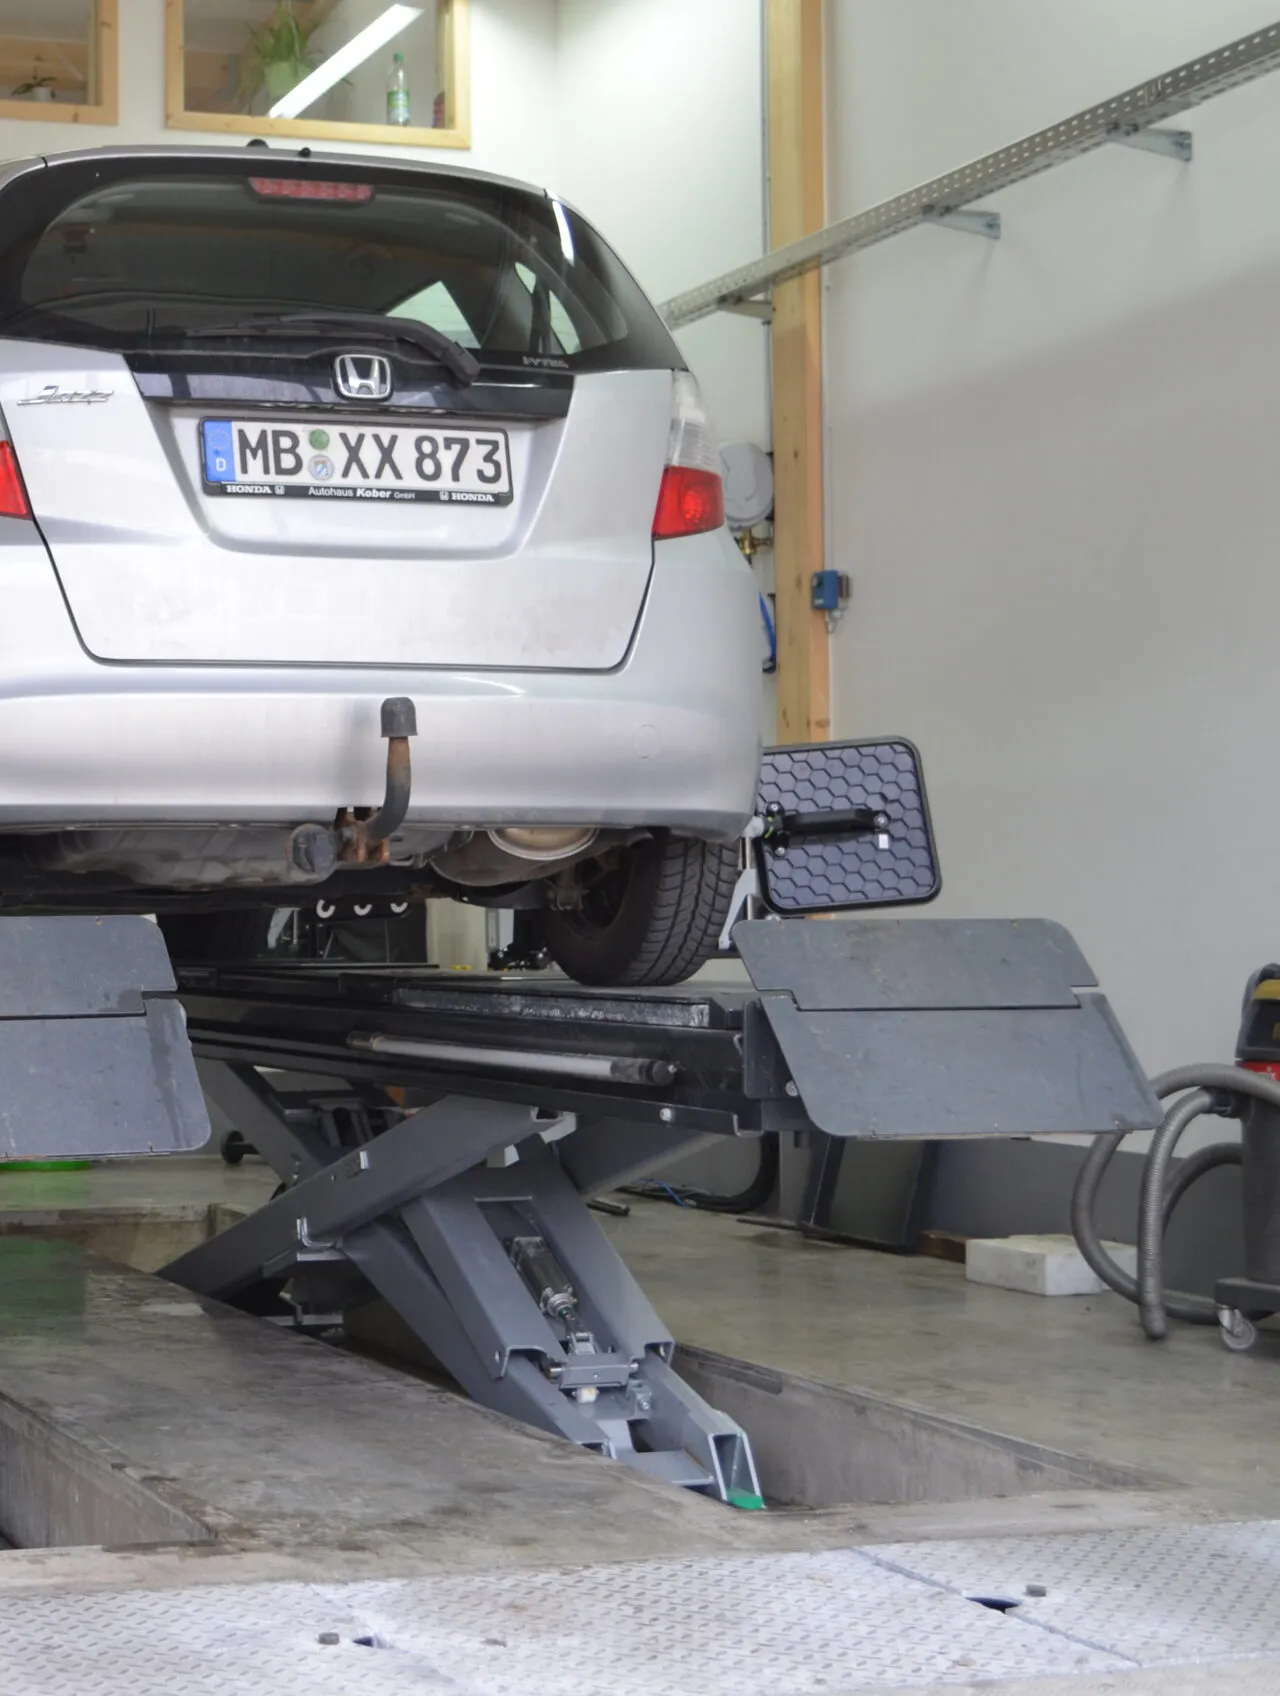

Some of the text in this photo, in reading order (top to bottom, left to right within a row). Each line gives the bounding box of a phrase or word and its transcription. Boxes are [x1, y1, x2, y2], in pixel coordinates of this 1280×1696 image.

[237, 428, 502, 484] MB XX 873
[215, 458, 227, 472] D
[226, 485, 272, 494] HONDA
[308, 486, 353, 497] Autohaus
[356, 488, 391, 498] Kober
[451, 493, 495, 502] HONDA
